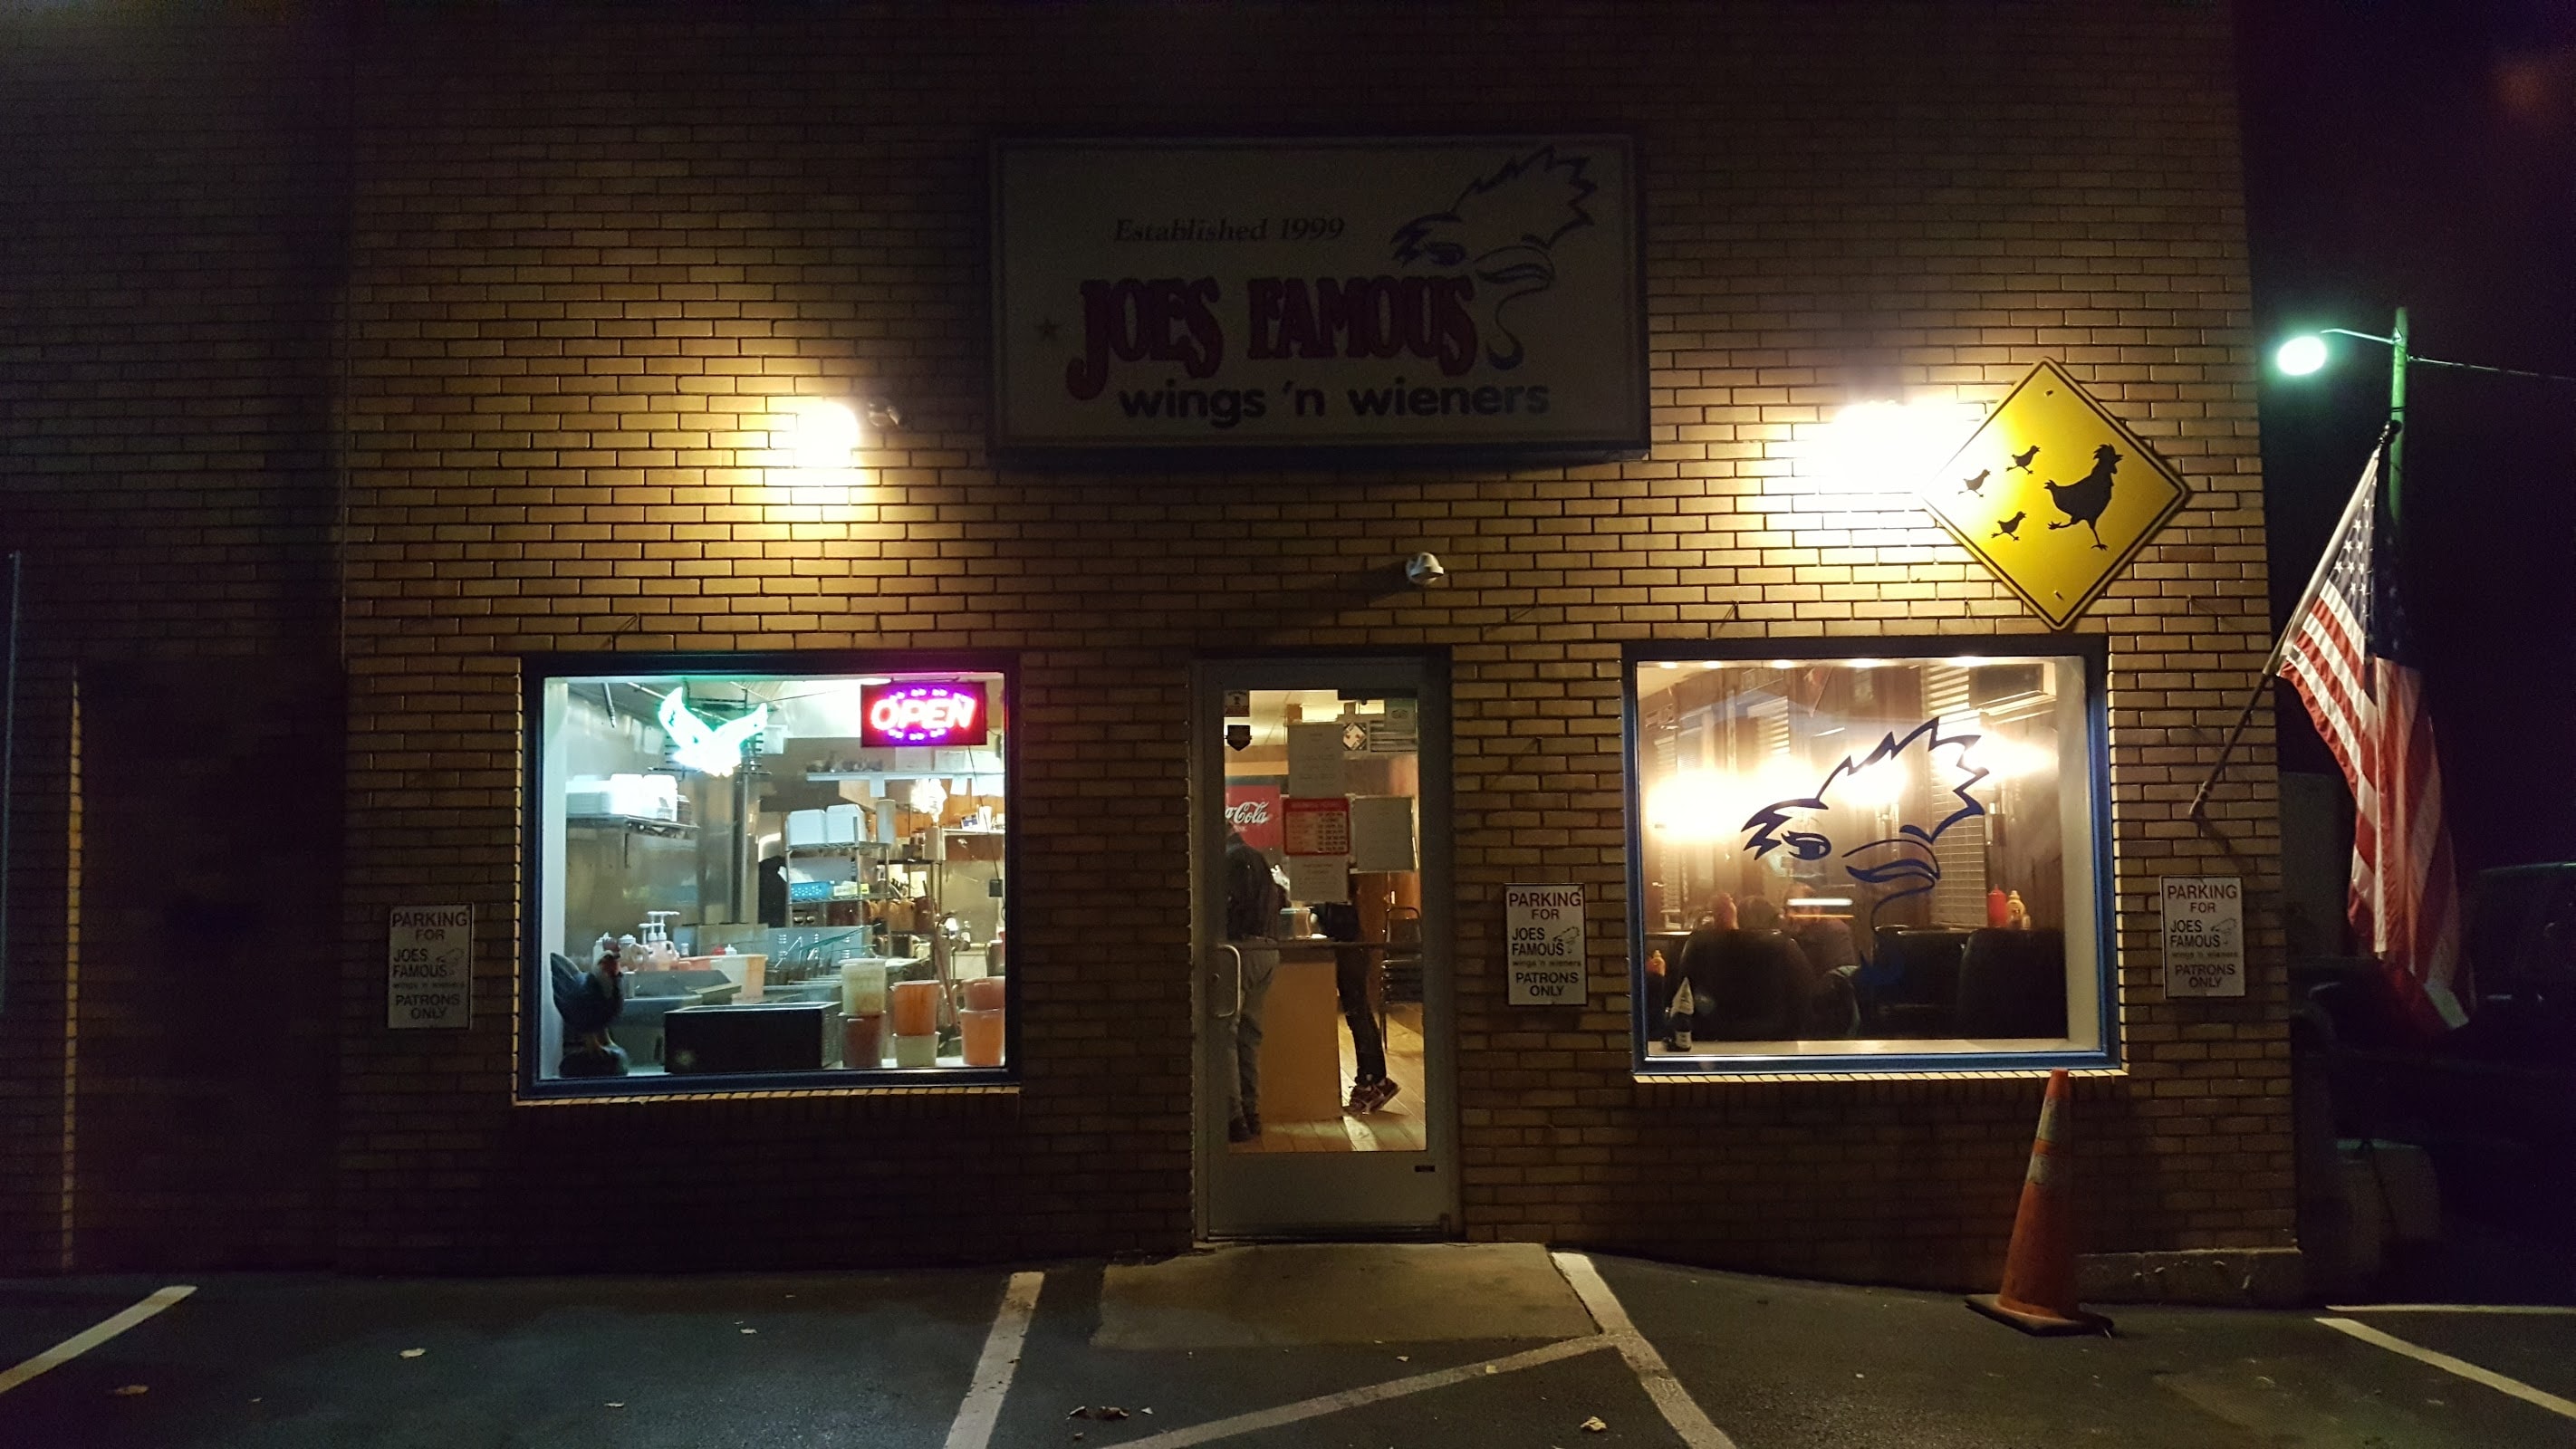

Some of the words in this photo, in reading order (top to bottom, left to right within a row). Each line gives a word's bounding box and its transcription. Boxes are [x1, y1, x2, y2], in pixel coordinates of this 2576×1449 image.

[1112, 217, 1269, 242] Established
[1278, 217, 1345, 241] 1999
[1066, 276, 1224, 400] JOES
[1246, 273, 1478, 378] FAMOUS
[1118, 379, 1266, 428] wings
[1347, 376, 1551, 417] wieners
[870, 695, 976, 730] OPEN
[1225, 801, 1271, 824] a-Cola
[2167, 885, 2237, 899] PARKING
[1509, 892, 1581, 907] PARKING
[1531, 908, 1559, 919] FOR
[2190, 902, 2216, 913] FOR
[391, 912, 467, 927] PARKING
[2170, 919, 2202, 933] JOES
[415, 929, 445, 941] FOR
[1512, 927, 1545, 941] JOES
[2170, 935, 2221, 947] FAMOUS
[393, 948, 428, 962] JOES
[1512, 943, 1564, 955] FAMOUS
[392, 964, 447, 978] FAMOUS
[2175, 964, 2235, 975] PATRONS
[1515, 972, 1579, 984] PATRONS
[2188, 976, 2222, 987] ONLY
[1530, 985, 1564, 996] ONLY
[395, 993, 461, 1006] PATRONS
[410, 1007, 447, 1019] ONLY
